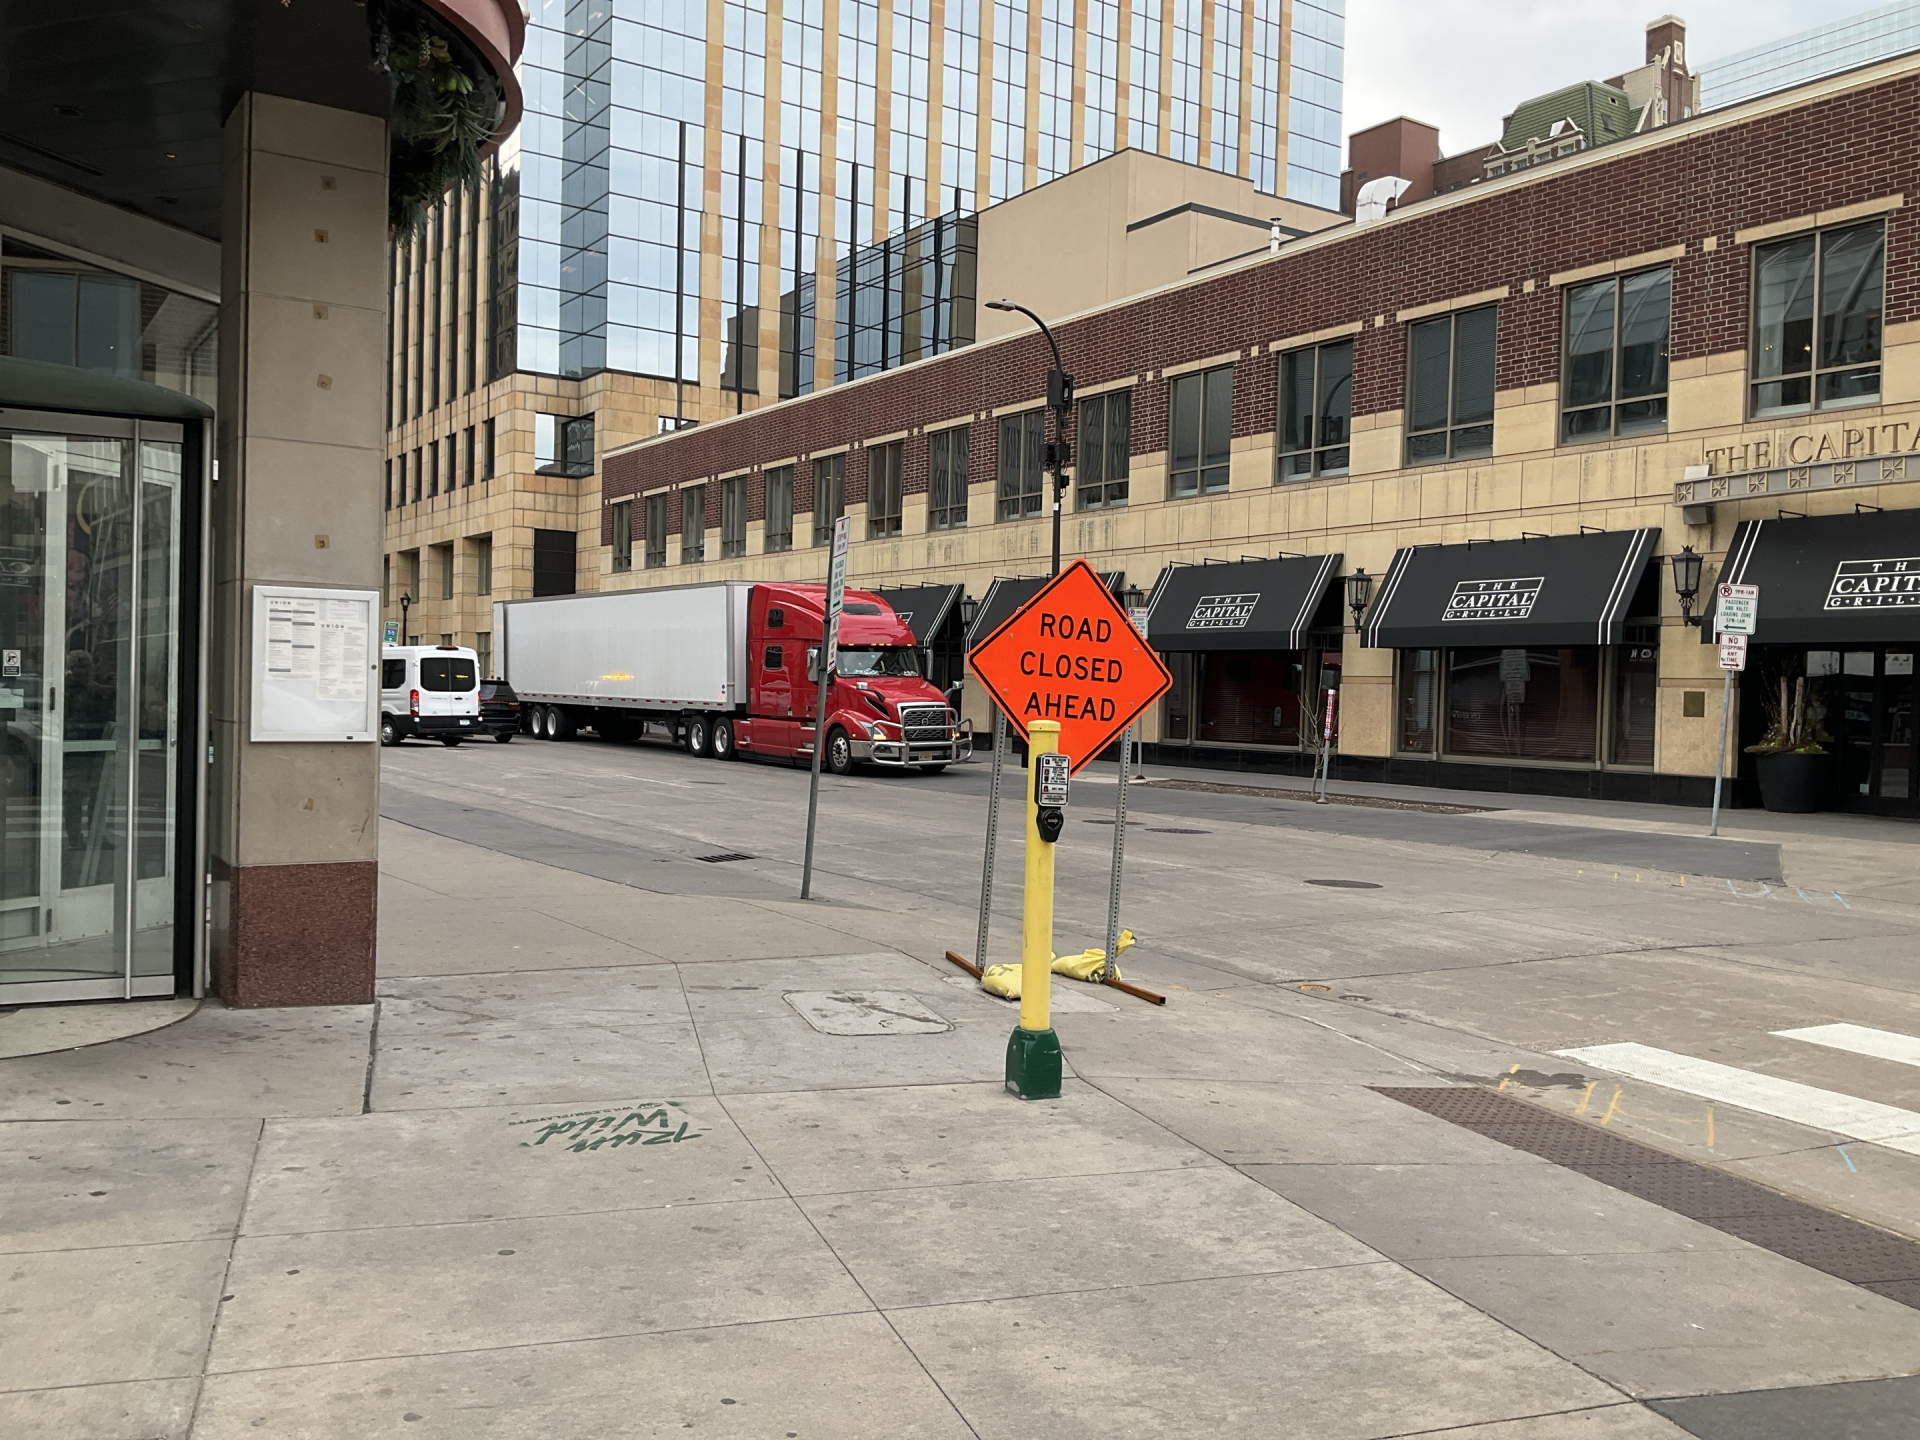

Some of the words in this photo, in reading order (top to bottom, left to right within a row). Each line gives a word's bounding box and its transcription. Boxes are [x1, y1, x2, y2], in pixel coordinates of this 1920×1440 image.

[1705, 440, 1771, 475] THE
[1452, 592, 1531, 608] CAPITAL
[1478, 582, 1518, 591] THE
[1836, 575, 1920, 594] CAPIT
[1194, 605, 1249, 618] CAPITAL
[1040, 612, 1112, 643] ROAD
[1728, 637, 1739, 645] NO
[1020, 650, 1122, 683] CLOSED
[1023, 691, 1116, 722] AHEAD
[534, 1108, 669, 1146] Wild
[564, 1121, 704, 1153] Run
